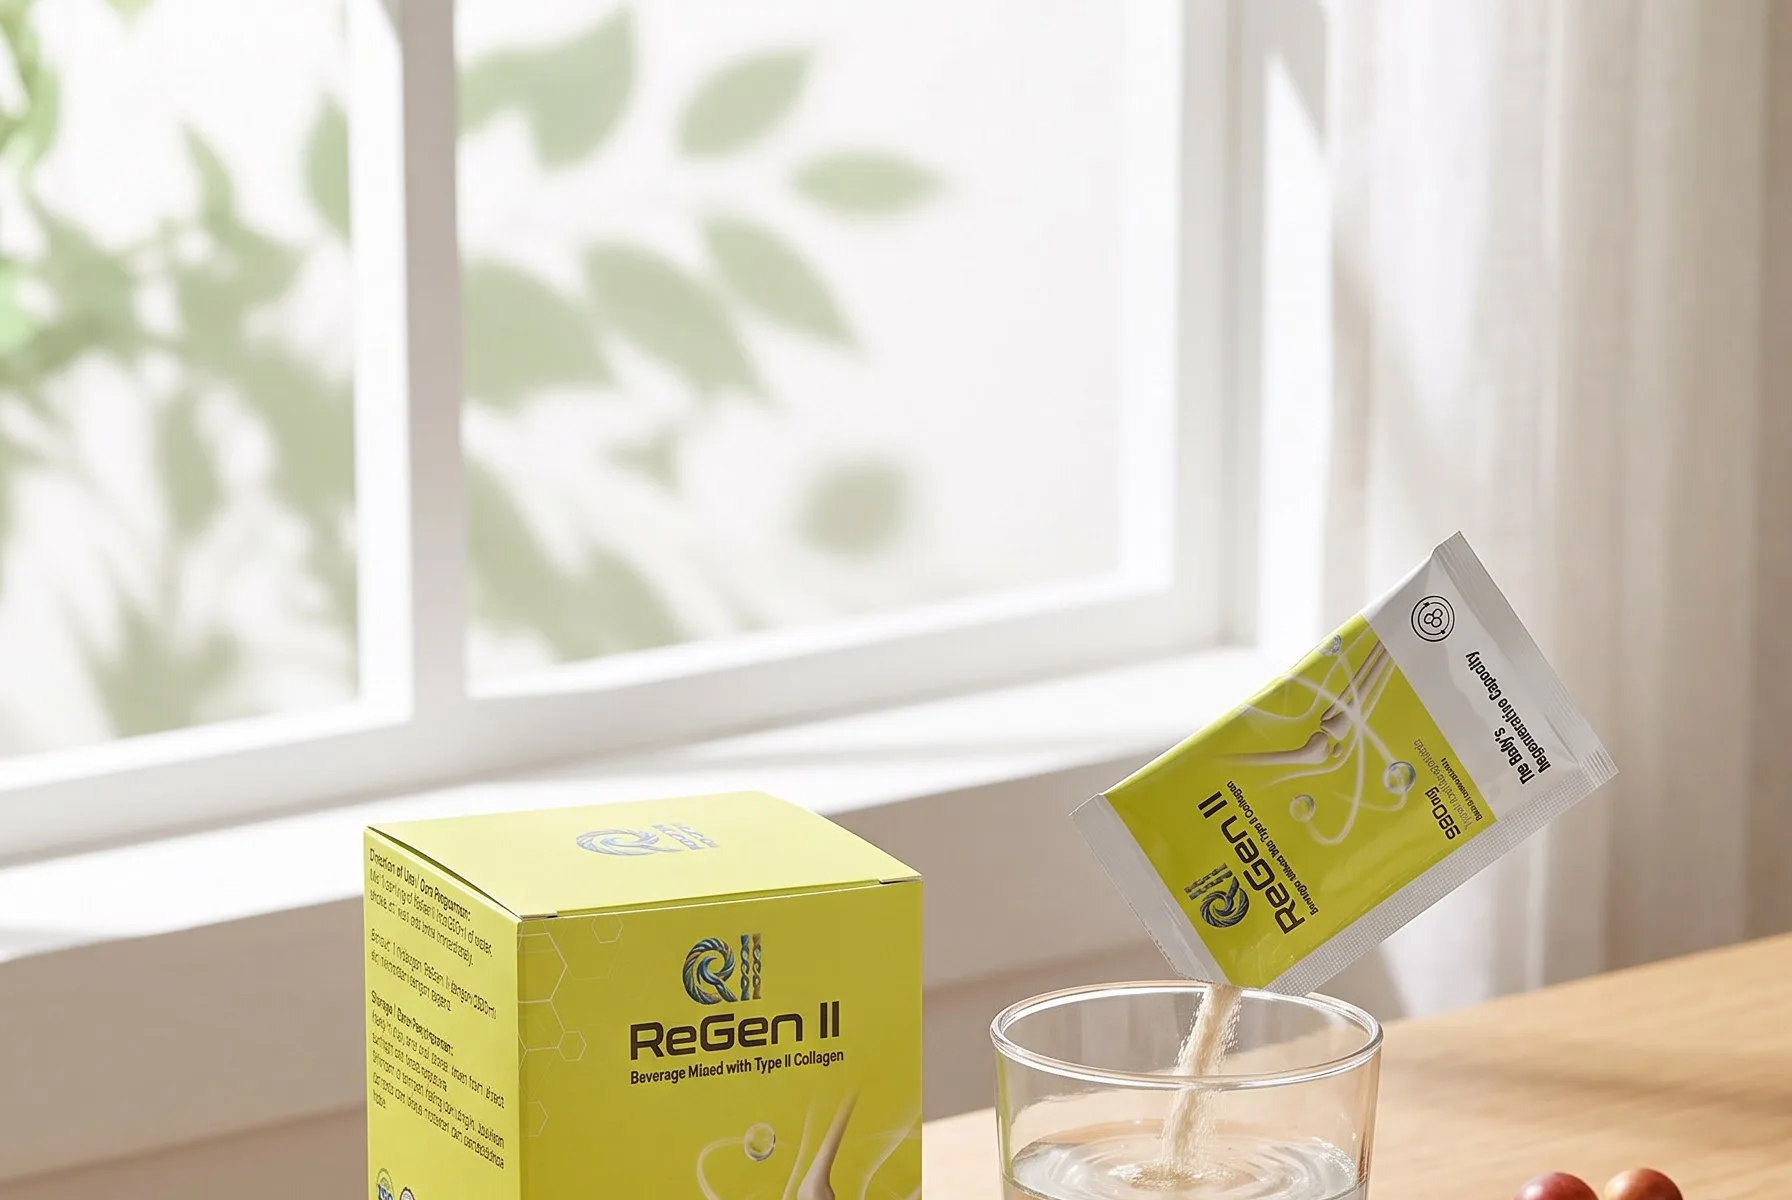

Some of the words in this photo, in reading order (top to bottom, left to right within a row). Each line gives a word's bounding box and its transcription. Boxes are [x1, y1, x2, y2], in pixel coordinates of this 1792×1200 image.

[1197, 790, 1228, 819] II
[1220, 815, 1306, 935] ReGen
[630, 1013, 803, 1061] ReGen
[819, 1000, 840, 1039] II
[630, 1068, 686, 1085] Beverage
[725, 1058, 752, 1075] with
[753, 1056, 782, 1075] Type
[784, 1053, 792, 1068] II
[793, 1050, 844, 1067] Collagen
